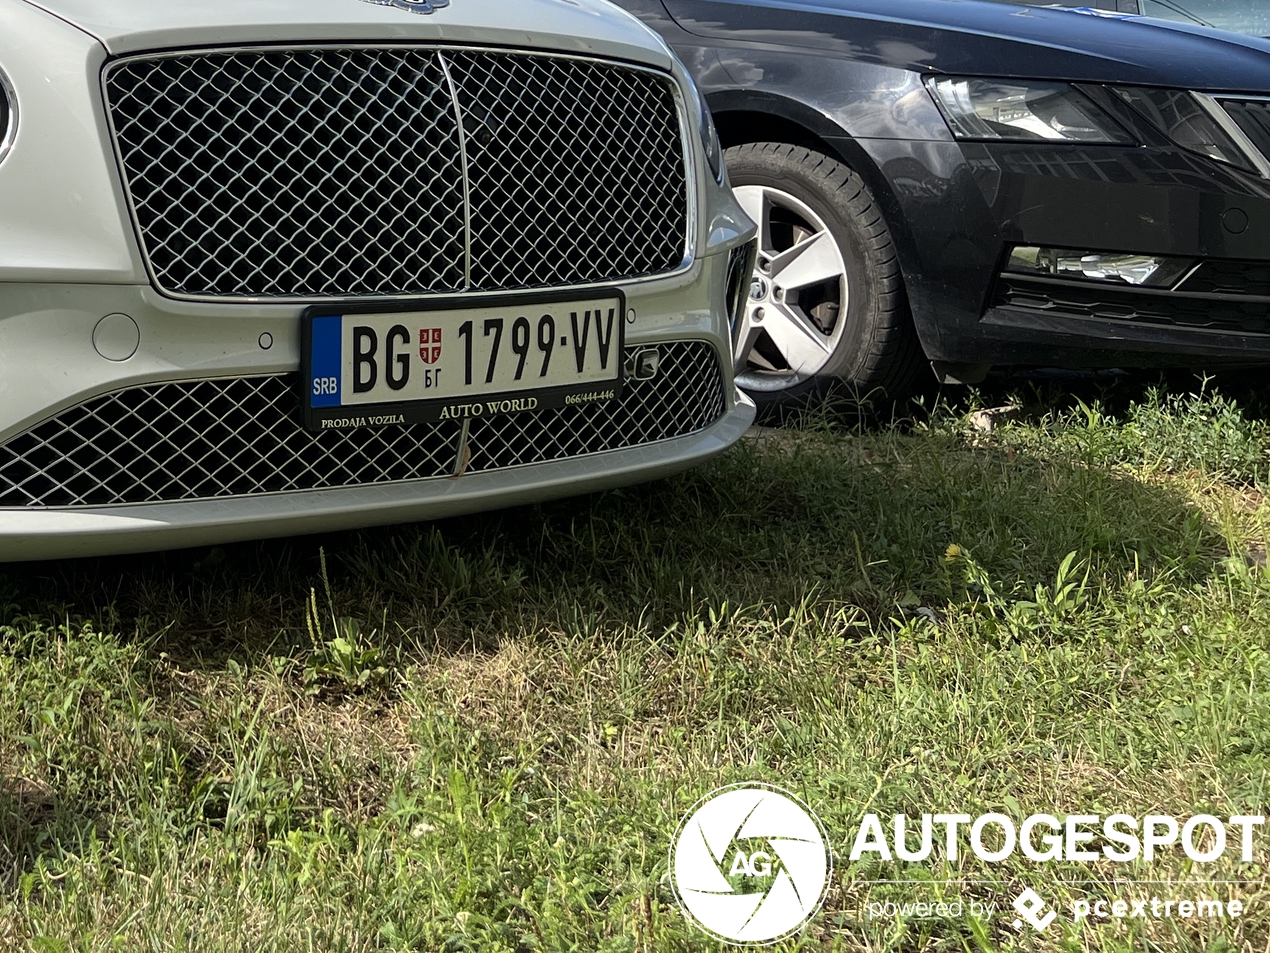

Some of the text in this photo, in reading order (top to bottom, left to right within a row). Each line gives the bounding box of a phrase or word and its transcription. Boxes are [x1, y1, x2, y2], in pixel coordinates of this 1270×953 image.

[353, 324, 411, 393] BG
[312, 376, 338, 396] SRB
[439, 397, 538, 420] AUTO WORLD
[321, 414, 405, 429] PRODAJA VOZILA
